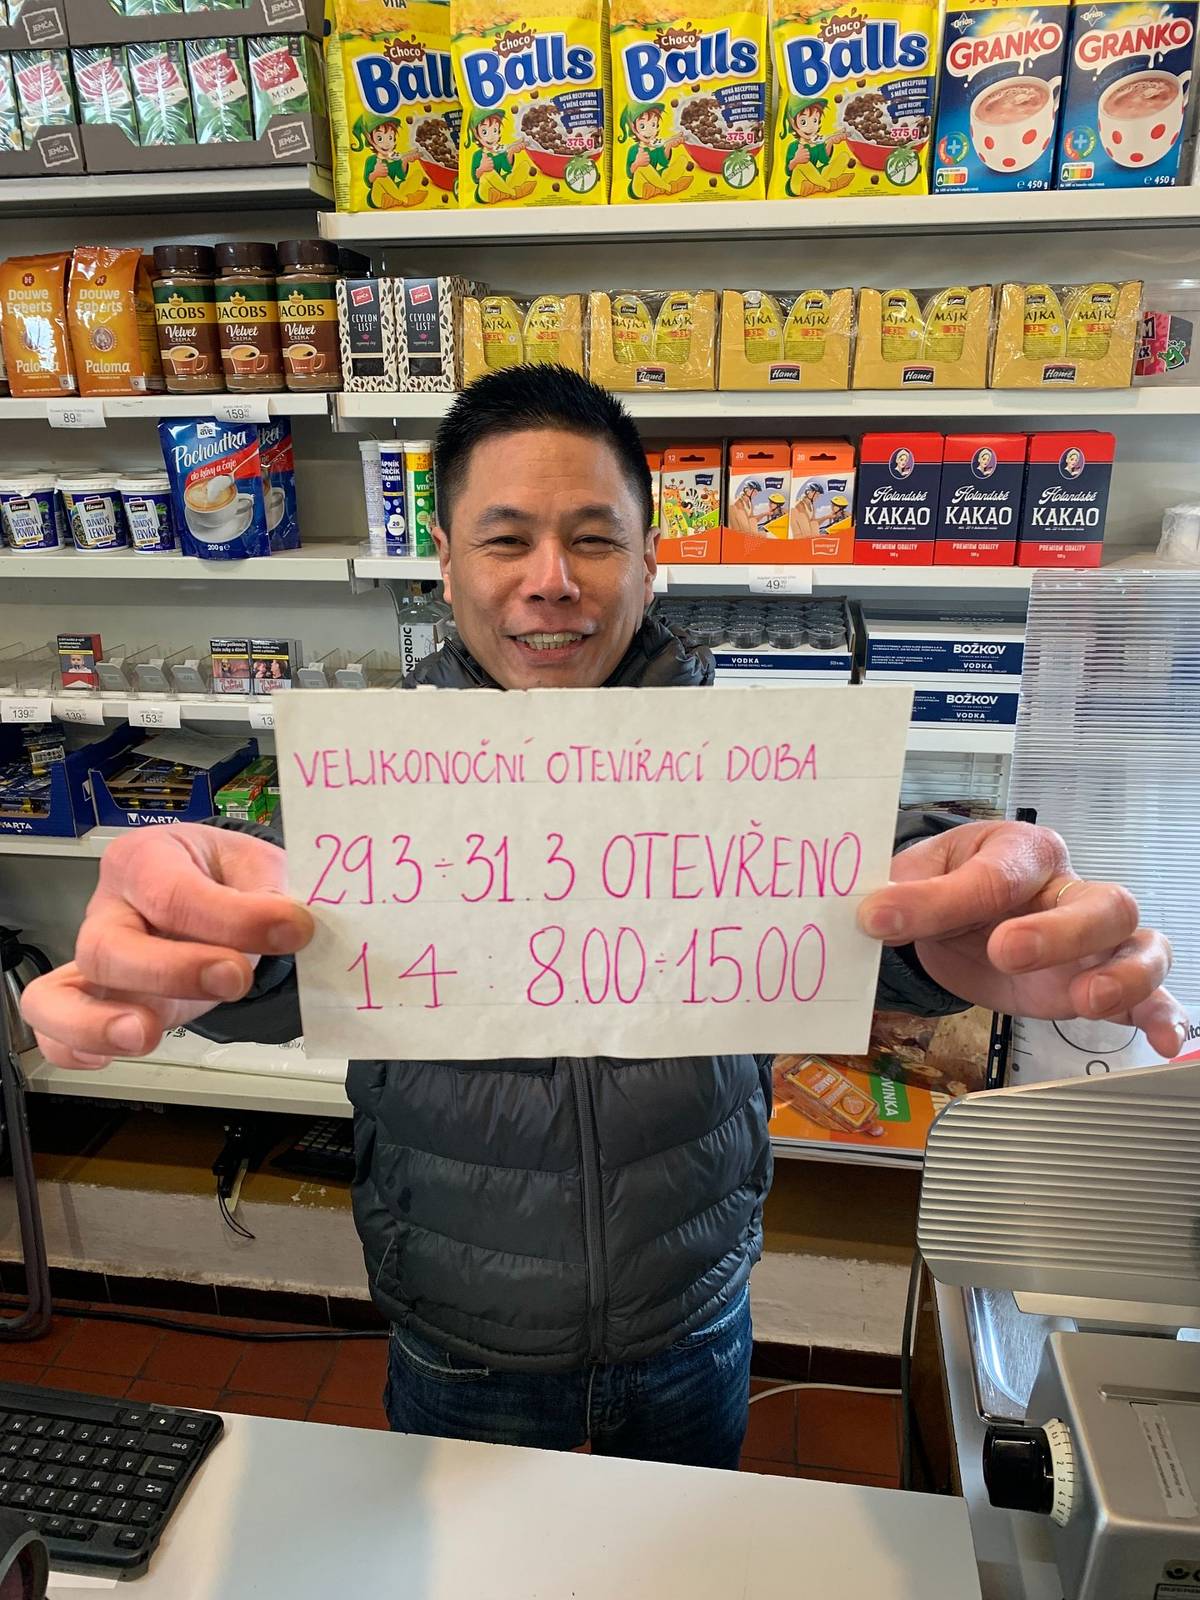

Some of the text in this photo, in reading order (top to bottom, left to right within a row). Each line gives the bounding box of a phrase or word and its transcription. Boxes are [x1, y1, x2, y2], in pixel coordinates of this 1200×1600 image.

[825, 21, 860, 37] Choco
[499, 36, 530, 51] Choco
[661, 35, 695, 46] Choco
[1079, 21, 1191, 63] GRANKO
[390, 46, 421, 58] Choco
[950, 25, 1060, 70] GRANKO
[625, 30, 758, 101] Balls
[787, 23, 927, 96] Balls
[465, 35, 593, 107] Balls
[356, 53, 459, 114] Ball
[726, 132, 754, 143] 375 g
[892, 128, 919, 139] 375 g
[279, 135, 300, 147] JEMČA
[566, 139, 594, 149] 375 g
[1027, 181, 1041, 189] 450
[1154, 176, 1169, 184] 450
[8, 289, 49, 301] Douwe
[79, 289, 120, 300] Douwe
[7, 302, 52, 314] Egberts
[156, 306, 206, 321] JACOBS
[217, 306, 267, 320] JACOBS
[352, 313, 378, 323] CEYLON
[409, 313, 436, 322] CEYLON
[165, 325, 198, 338] Velvet
[226, 324, 258, 337] Velvet
[285, 323, 317, 336] Velvet
[358, 323, 373, 332] LIST
[416, 322, 431, 331] LIST
[85, 359, 131, 373] Paloma
[772, 369, 798, 379] Hamé
[905, 371, 931, 381] Hamé
[1046, 368, 1074, 378] Hamé
[64, 413, 76, 423] 89
[226, 408, 244, 419] 159
[171, 430, 247, 473] Pochoutka
[191, 472, 200, 480] do
[221, 459, 237, 471] čaje
[870, 485, 929, 504] Holandské
[951, 485, 1010, 504] Holandské
[1038, 485, 1098, 505] Holandské
[864, 506, 931, 525] KAKAO
[945, 506, 1012, 525] KAKAO
[1032, 507, 1099, 526] KAKAO
[88, 525, 113, 539] LEKVÁR
[134, 528, 157, 540] LEKVÁR
[766, 579, 780, 590] 49
[403, 626, 416, 673] NORDIC
[953, 643, 1006, 655] BOŽKOV
[946, 693, 998, 704] BOŽKOV
[13, 710, 29, 718] 139
[141, 714, 157, 723] 153
[293, 736, 817, 788] VELIKONOČNÍ OTEVÍRACÍ DOBA
[141, 815, 181, 824] VARTA
[602, 820, 862, 899] OTEVŘENO
